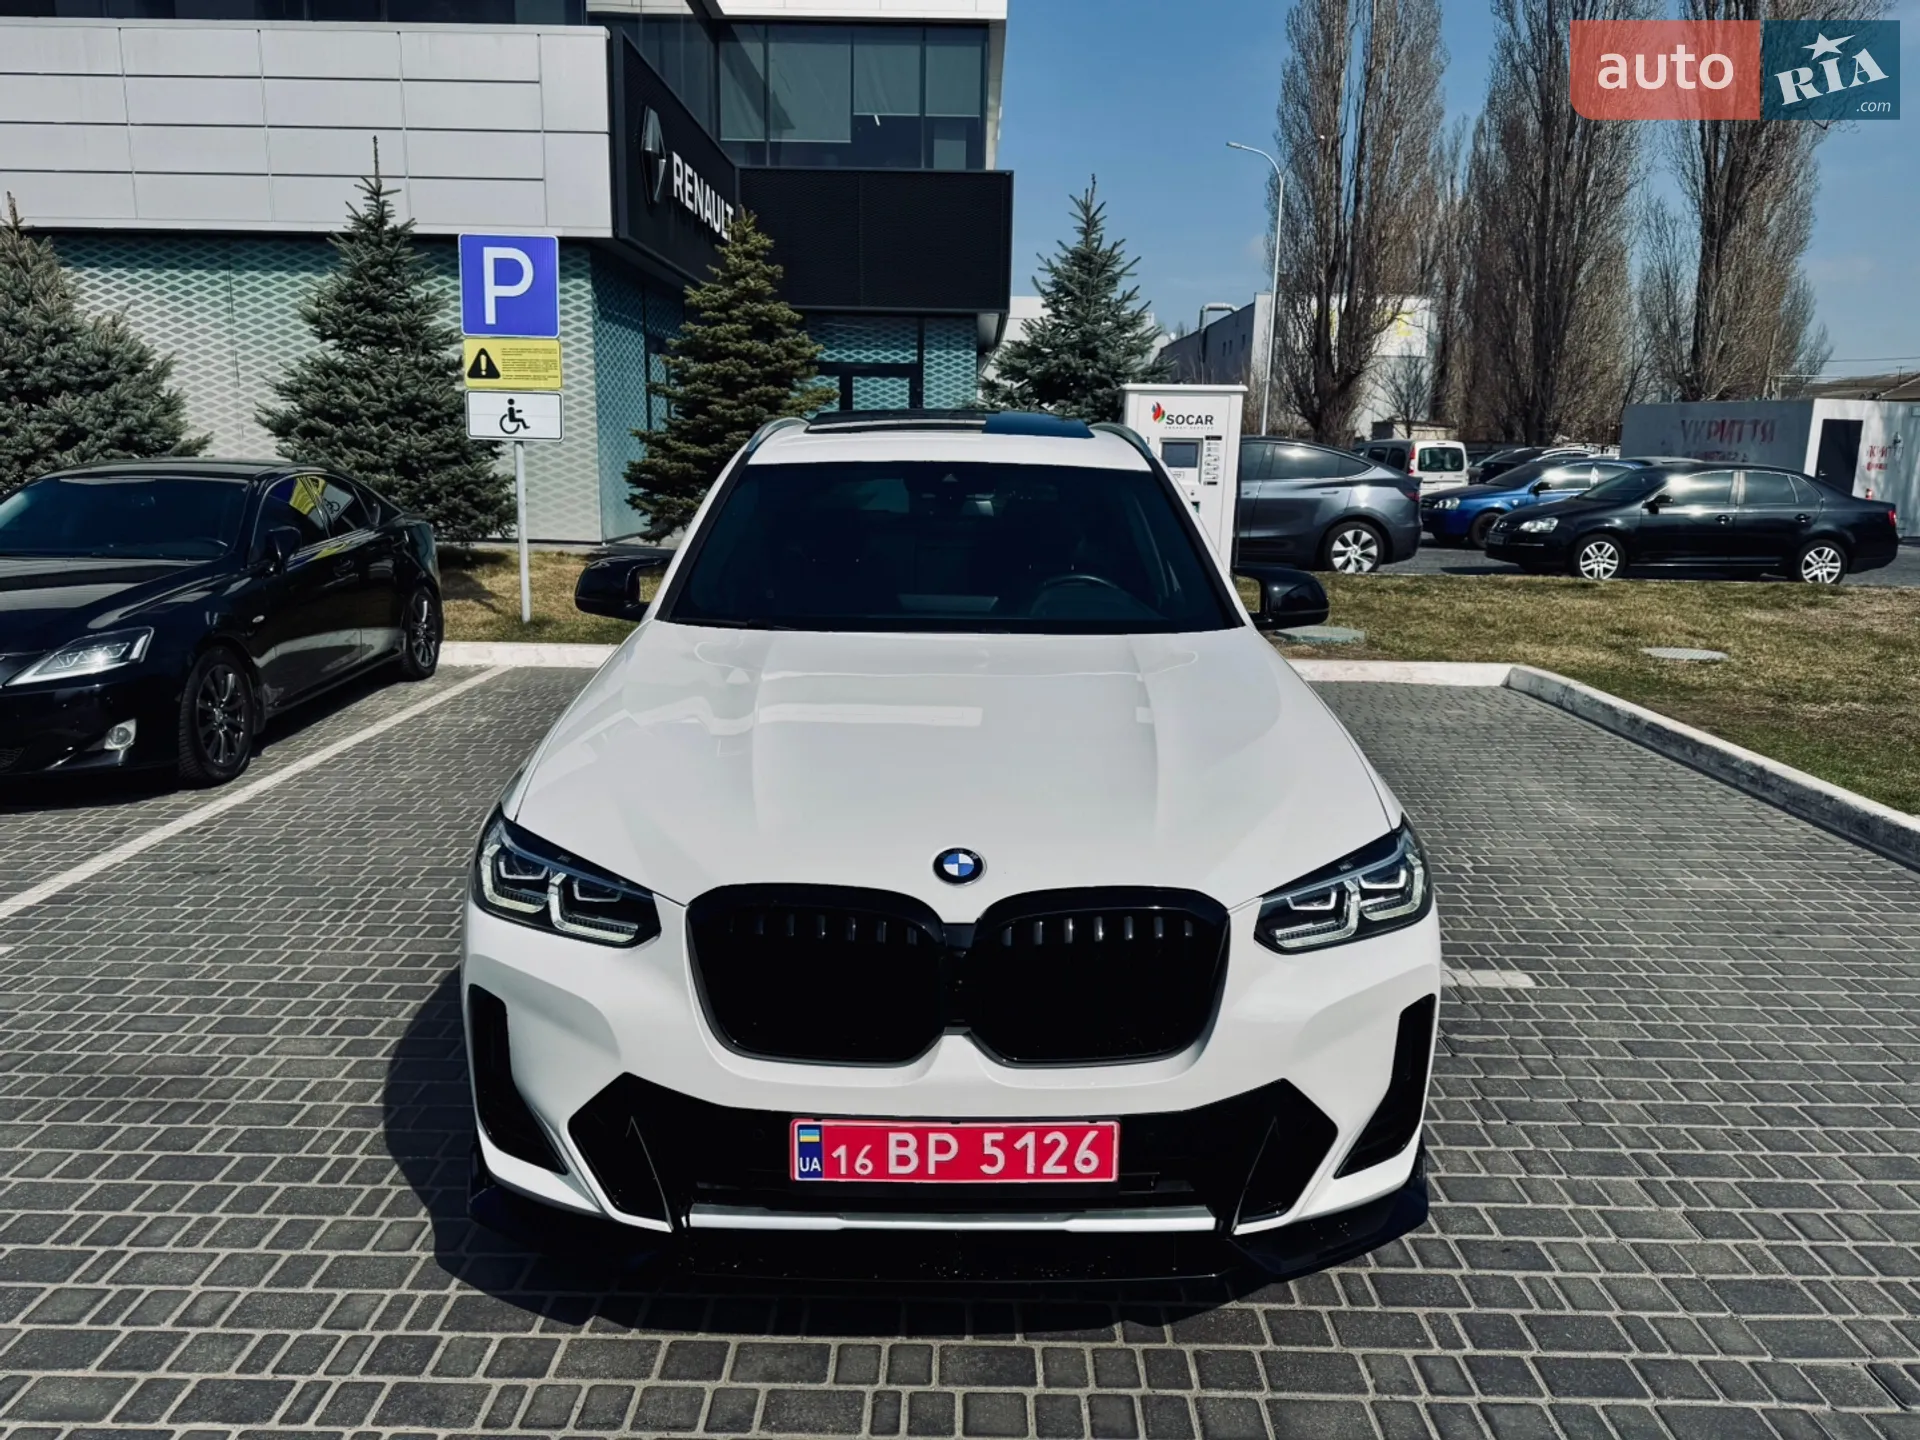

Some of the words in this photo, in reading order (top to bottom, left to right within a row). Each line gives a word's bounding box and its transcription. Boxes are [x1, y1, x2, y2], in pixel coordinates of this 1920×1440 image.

[672, 151, 734, 242] RENAULT
[483, 247, 534, 325] P
[1166, 414, 1214, 425] SOCAR
[800, 1157, 821, 1172] UA
[831, 1145, 873, 1175] 16
[888, 1132, 959, 1175] BP
[979, 1130, 1099, 1175] 5126
